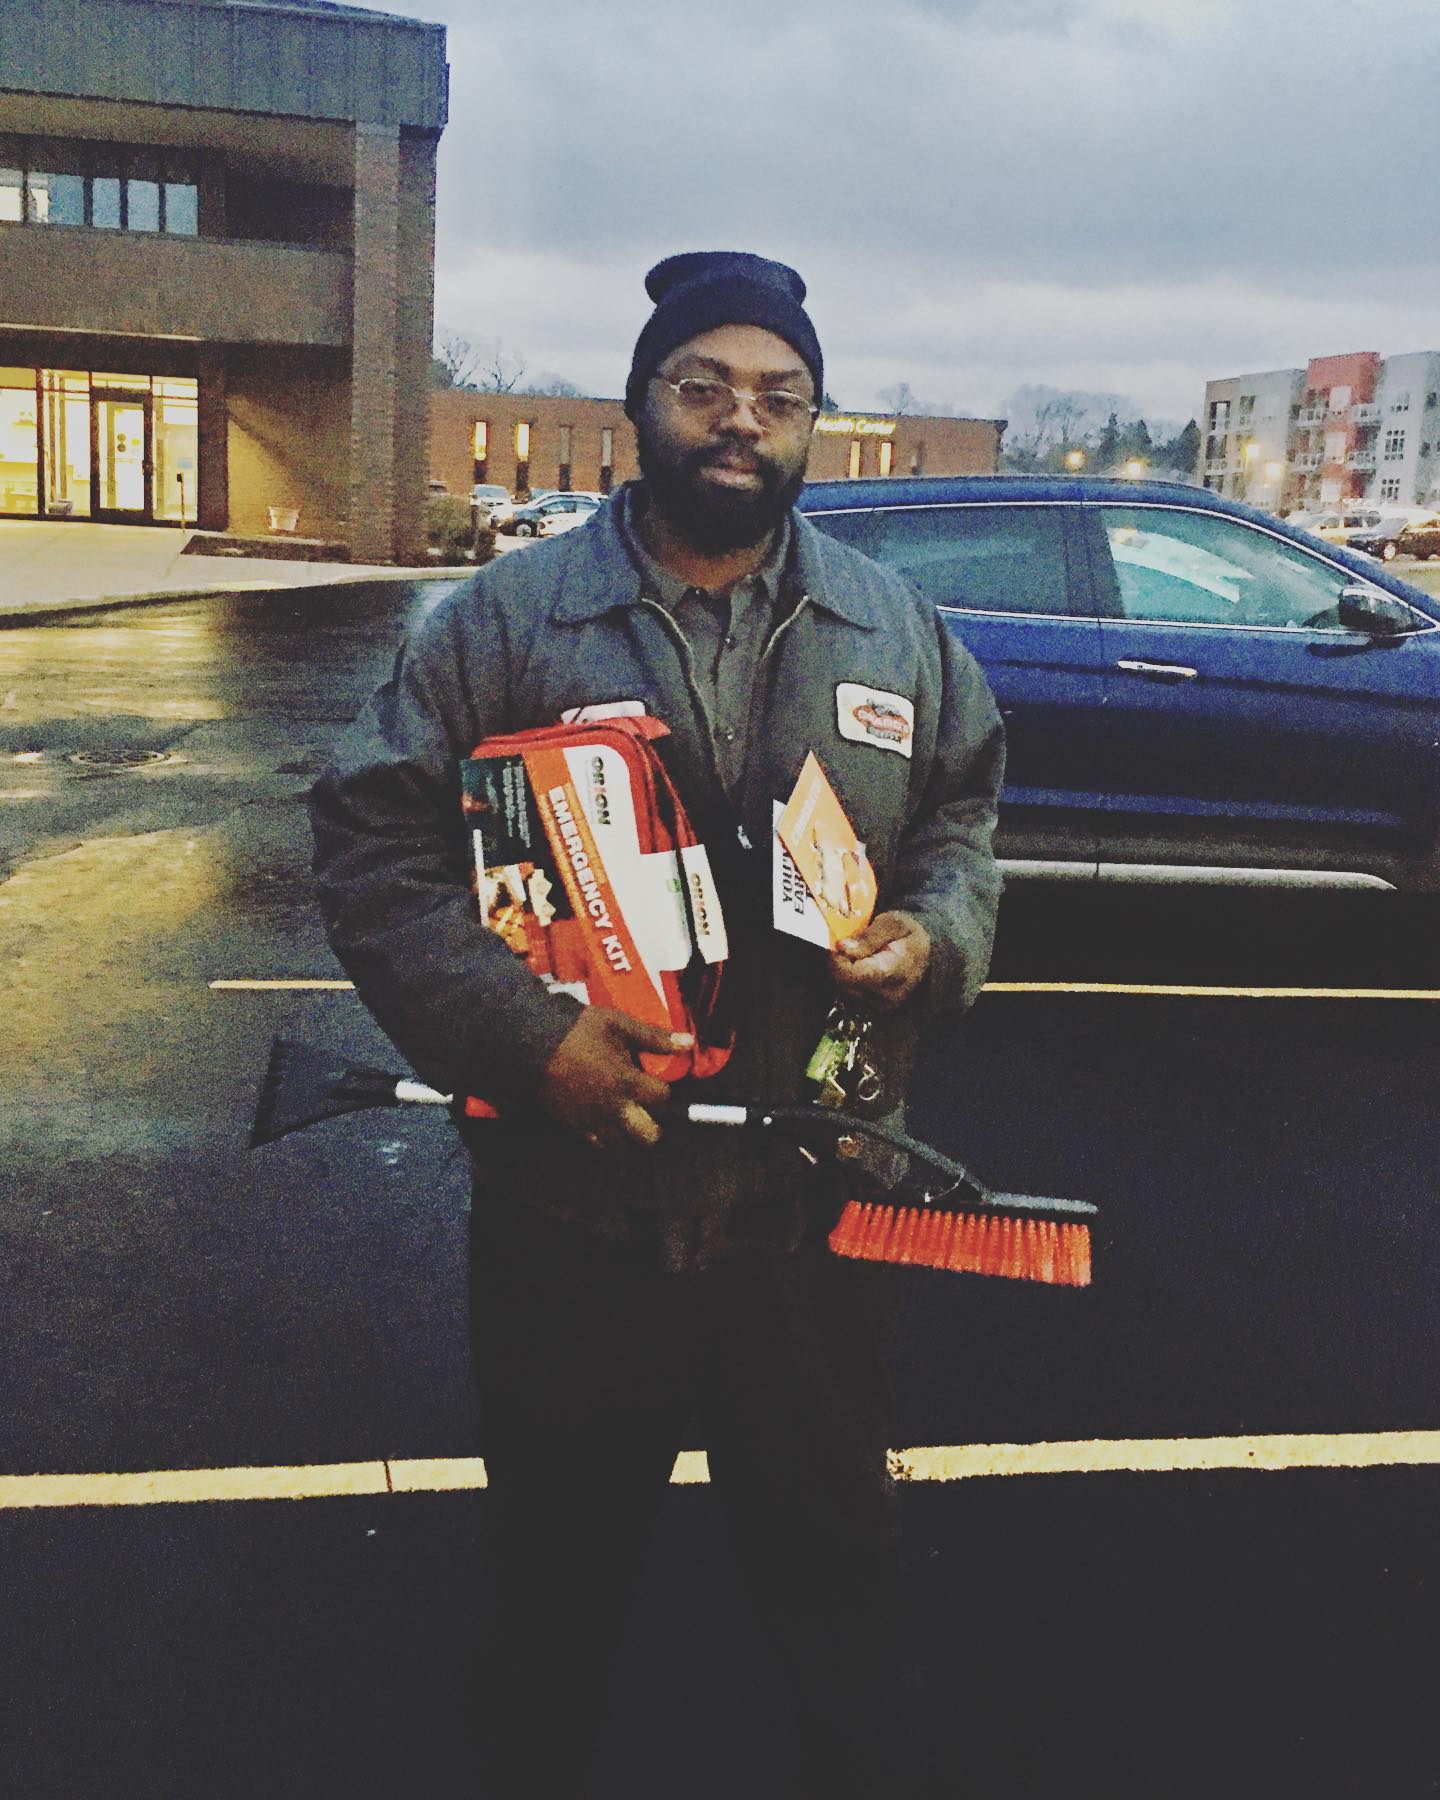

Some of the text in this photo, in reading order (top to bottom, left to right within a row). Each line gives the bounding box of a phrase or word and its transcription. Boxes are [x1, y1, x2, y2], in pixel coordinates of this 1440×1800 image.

[855, 419, 896, 435] Center
[548, 785, 632, 972] EMERGENCY KIT
